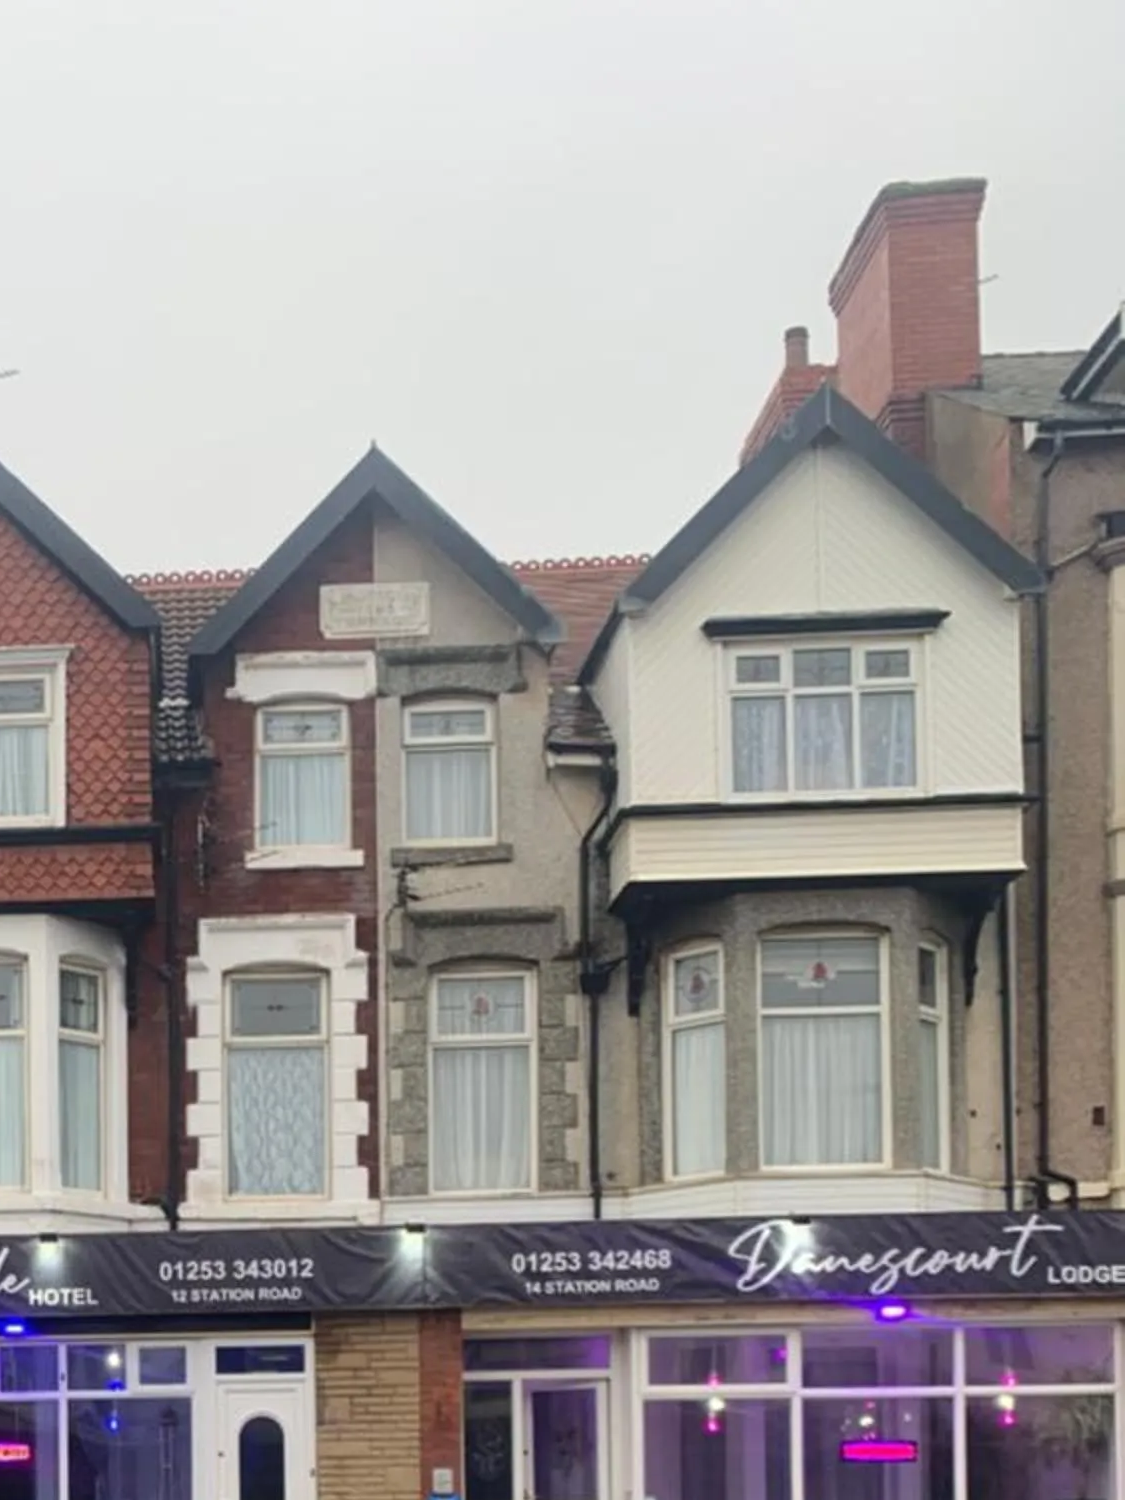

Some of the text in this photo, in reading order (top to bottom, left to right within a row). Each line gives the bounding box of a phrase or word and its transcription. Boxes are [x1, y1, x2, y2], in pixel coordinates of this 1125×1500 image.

[511, 1249, 671, 1273] 01253 342468
[728, 1214, 1125, 1295] Danescourt LODGE
[159, 1258, 314, 1281] 01253 343012
[28, 1287, 99, 1306] HOTEL
[172, 1287, 302, 1304] 12 STATION ROAD
[525, 1278, 660, 1295] 14 STATION ROAD
